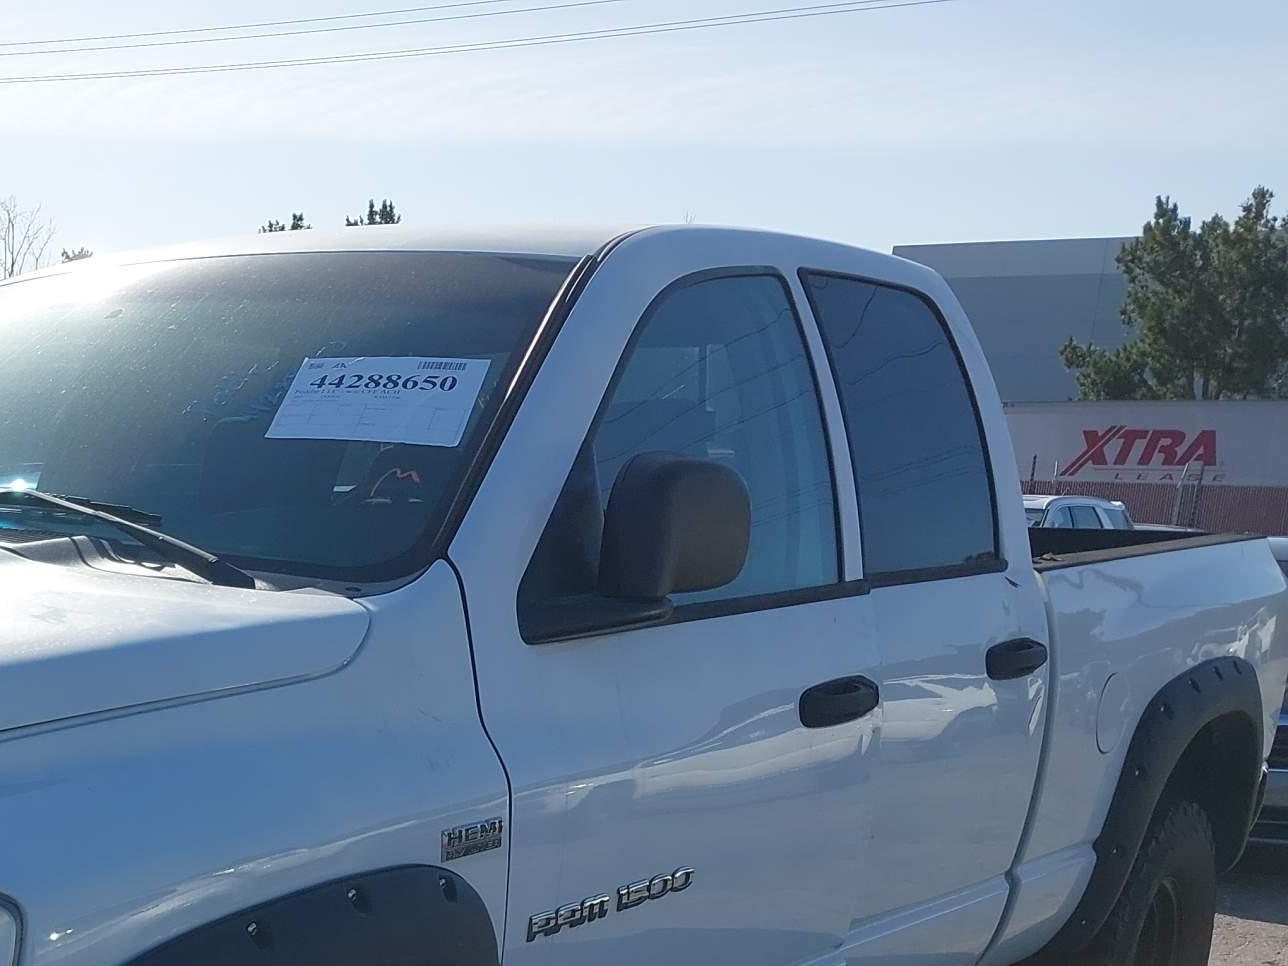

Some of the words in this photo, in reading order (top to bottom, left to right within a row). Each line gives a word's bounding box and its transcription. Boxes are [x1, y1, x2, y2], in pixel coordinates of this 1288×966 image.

[309, 373, 459, 393] 44288650
[1059, 424, 1217, 477] XTRA
[446, 820, 503, 848] HEMI
[616, 865, 696, 913] 1500
